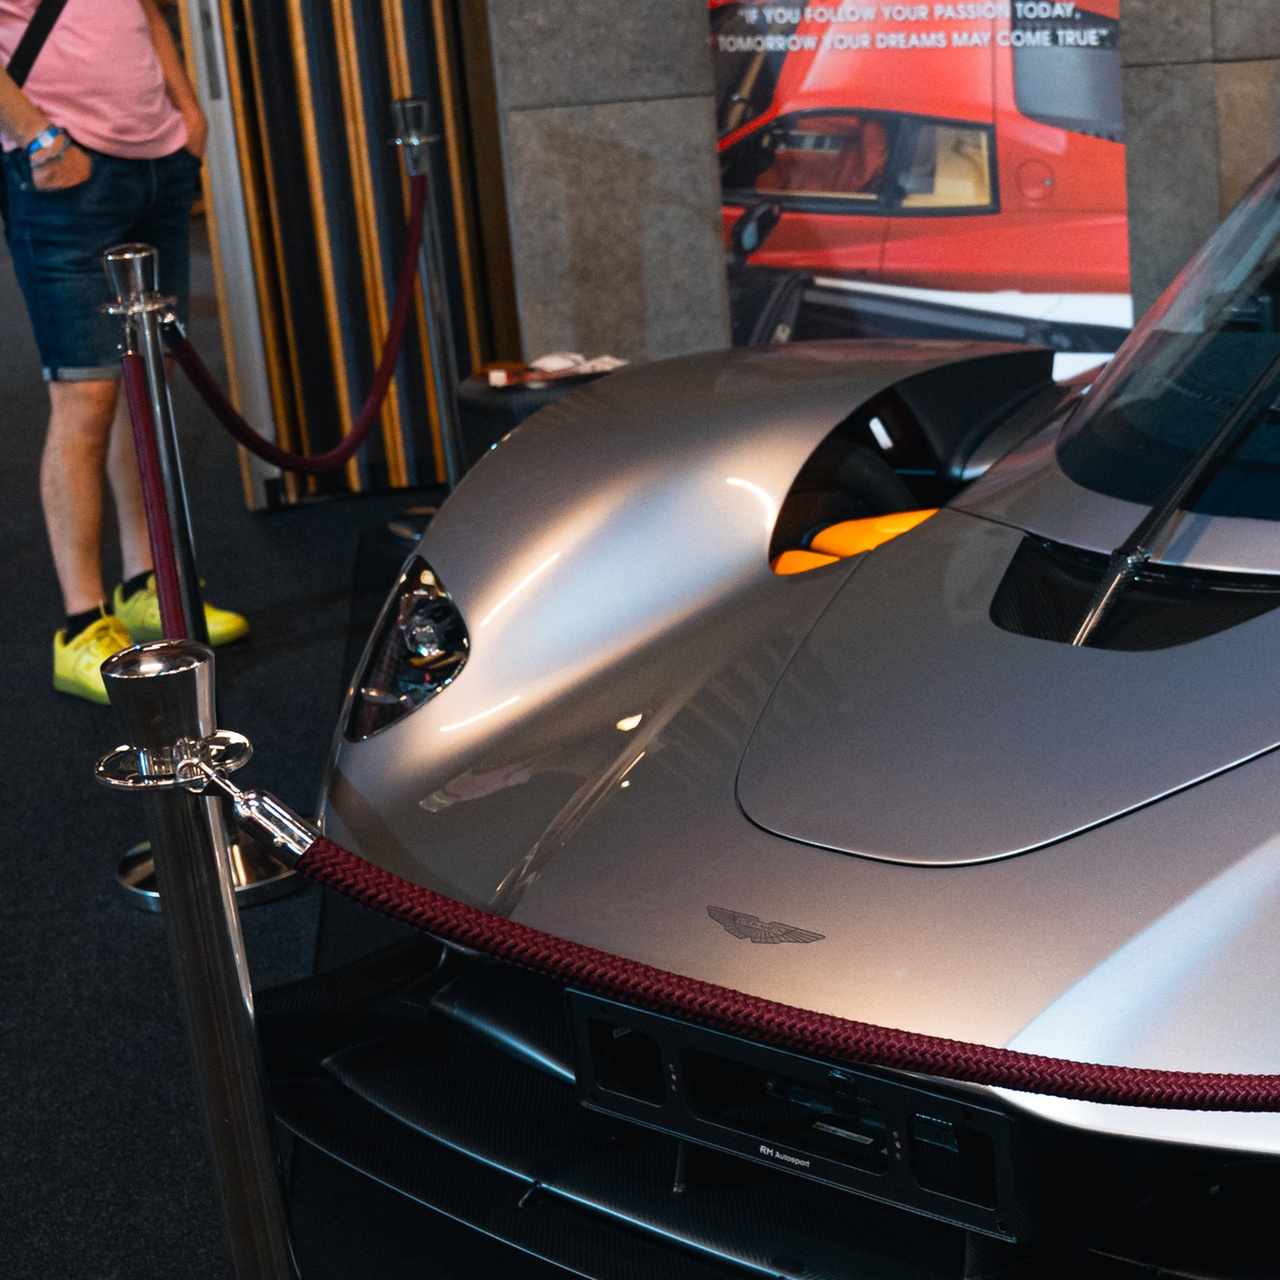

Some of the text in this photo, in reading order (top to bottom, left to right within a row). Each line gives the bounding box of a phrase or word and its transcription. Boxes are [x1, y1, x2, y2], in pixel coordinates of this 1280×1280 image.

[763, 7, 800, 24] YOU
[804, 5, 877, 24] FOLLOW
[882, 4, 929, 22] YOUR
[933, 2, 1011, 20] PASSION
[718, 33, 818, 52] TOMORROW
[822, 32, 871, 51] YOUR
[876, 30, 947, 49] DREAMS
[952, 30, 992, 48] MAY
[996, 28, 1051, 47] COME
[759, 1145, 810, 1168] RM Autosport
